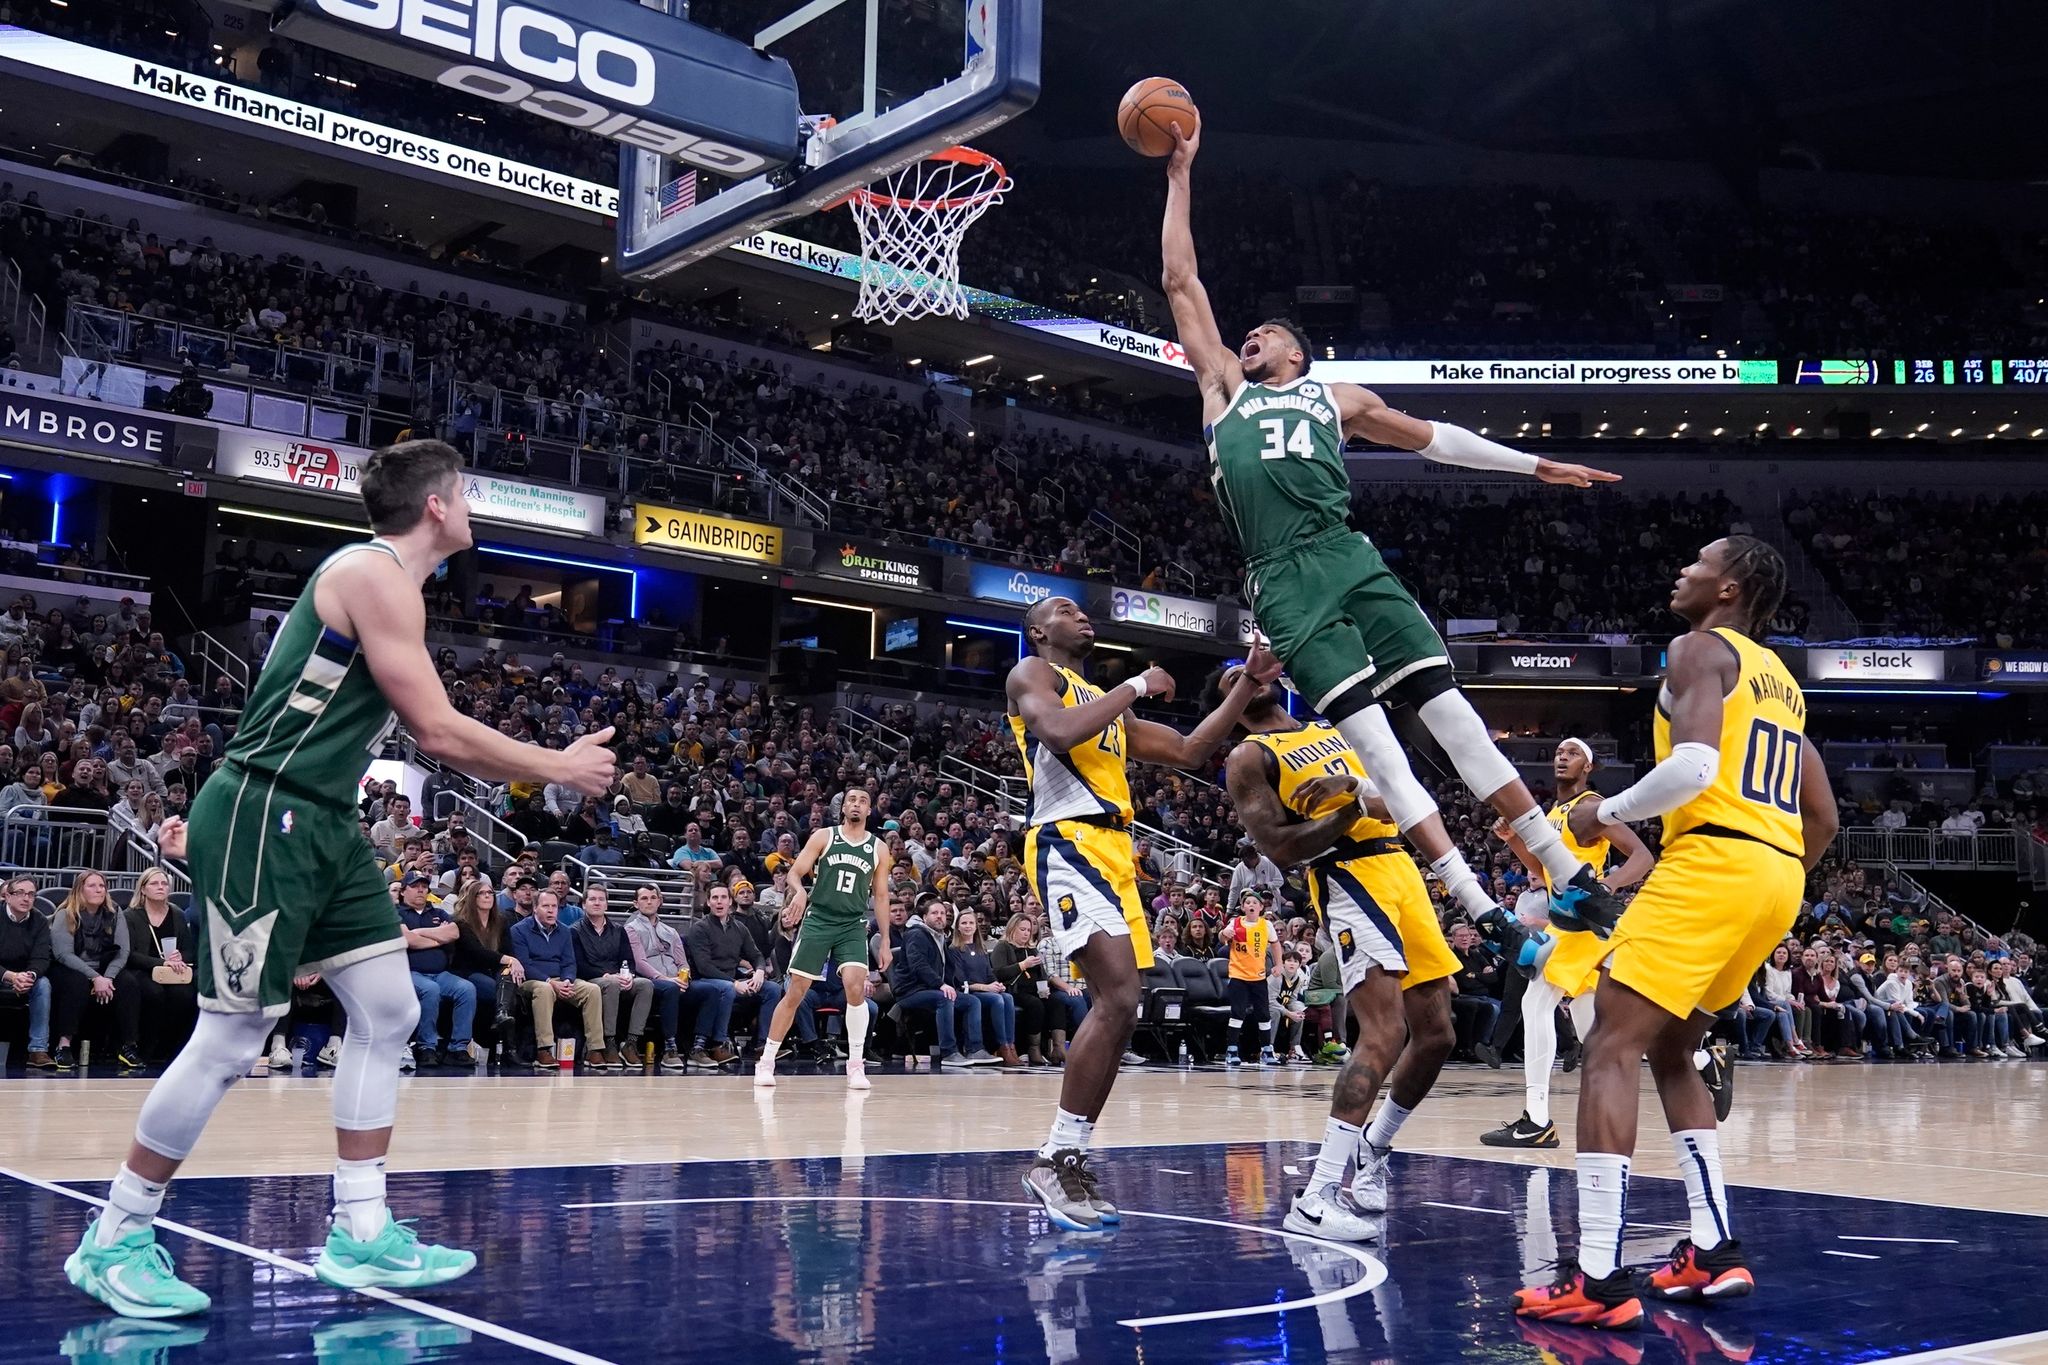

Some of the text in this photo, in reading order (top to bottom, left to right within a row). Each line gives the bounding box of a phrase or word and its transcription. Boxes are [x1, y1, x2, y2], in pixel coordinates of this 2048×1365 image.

[223, 14, 245, 31] 225
[437, 65, 765, 173] GEICO
[133, 64, 206, 103] Make
[214, 86, 325, 134] financial
[331, 121, 439, 165] progress
[446, 152, 491, 178] one
[498, 161, 575, 201] bucket
[580, 189, 602, 207] at
[735, 232, 843, 274] he red key.
[1100, 329, 1161, 358] KeyBank
[1430, 363, 1484, 381] Make
[1490, 362, 1575, 381] financial
[1580, 363, 1672, 384] progress
[1677, 367, 1718, 381] one
[1914, 369, 1936, 384] 26
[1915, 360, 1934, 369] REB
[1963, 360, 1983, 369] AST
[1964, 369, 1984, 384] 19
[2008, 360, 2035, 369] FIELD
[1237, 394, 1335, 426] MILWAUKEE
[5, 404, 164, 453] MBROSE
[1259, 418, 1315, 460] 34
[254, 450, 281, 469] 93.5
[284, 442, 330, 470] the
[292, 463, 340, 490] fan
[344, 465, 361, 482] 10
[187, 481, 205, 496] EXIT
[490, 481, 576, 505] Peyton Manning
[489, 494, 586, 519] Children's Hospital
[667, 518, 776, 556] GAINBRIDGE
[842, 553, 921, 577] DRAFTKINGS
[860, 569, 919, 586] SPORTSBOOK
[1112, 591, 1215, 633] aes Indiana
[1511, 655, 1571, 669] verizon
[1862, 652, 1912, 668] slack
[2005, 661, 2018, 673] WE
[2018, 661, 2042, 673] GROW
[1749, 673, 1804, 720] MATHURIN
[1097, 719, 1121, 759] 23
[1741, 717, 1802, 815] 00
[826, 853, 872, 875] MILWAUKEE
[836, 869, 857, 894] 13
[1235, 942, 1248, 954] 34
